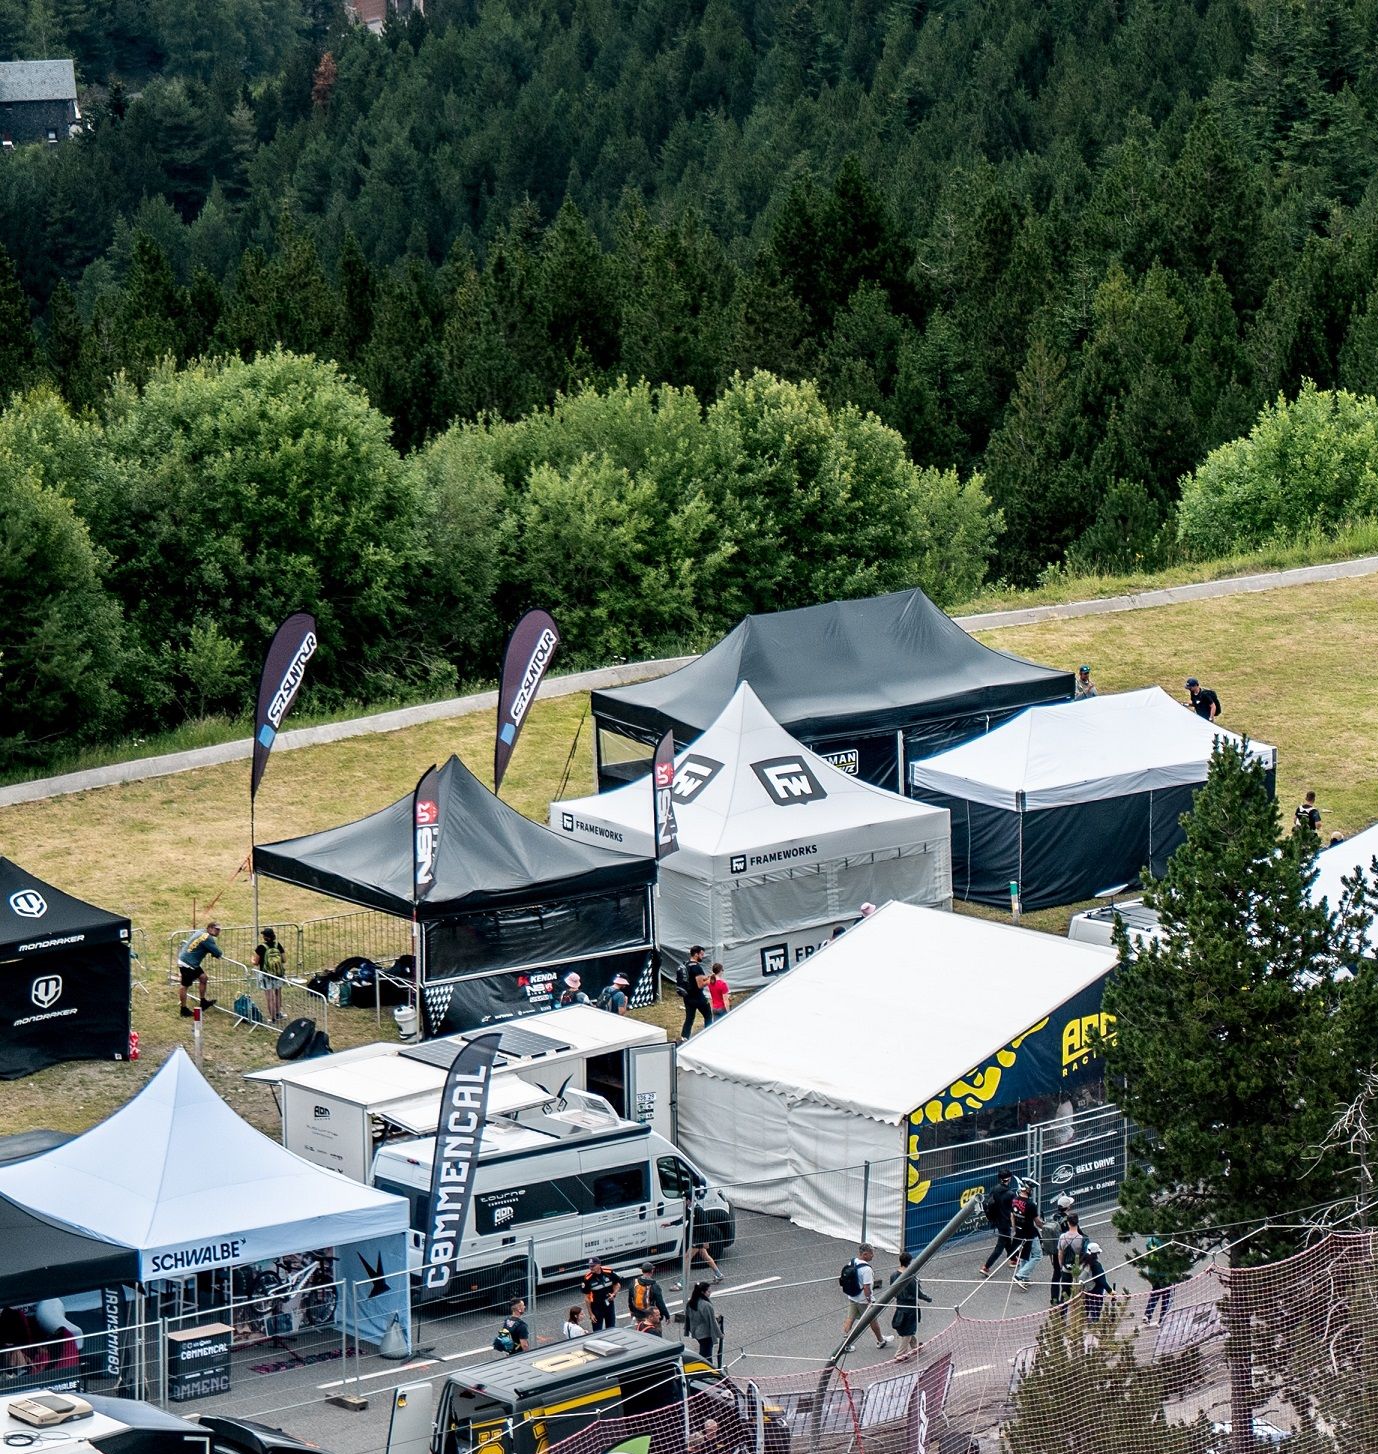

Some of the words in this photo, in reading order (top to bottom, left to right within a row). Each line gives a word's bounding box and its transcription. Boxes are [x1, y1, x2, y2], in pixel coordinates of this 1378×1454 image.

[281, 633, 315, 695] SUNTOUR
[523, 630, 555, 692] SUNTOUR
[576, 819, 623, 843] FRAMEWORKS
[750, 844, 818, 866] FRAMEWORKS
[19, 934, 85, 951] MONDRAKER
[530, 972, 557, 984] KENDA
[13, 1008, 78, 1026] MONDRAKER
[1063, 1039, 1117, 1077] RACIG
[1076, 1162, 1093, 1173] BELT
[1094, 1156, 1115, 1169] DRIVE
[428, 1065, 487, 1288] COMMENCAL
[151, 1240, 240, 1273] SCHWALBE
[181, 1342, 228, 1360] COMMENCAL
